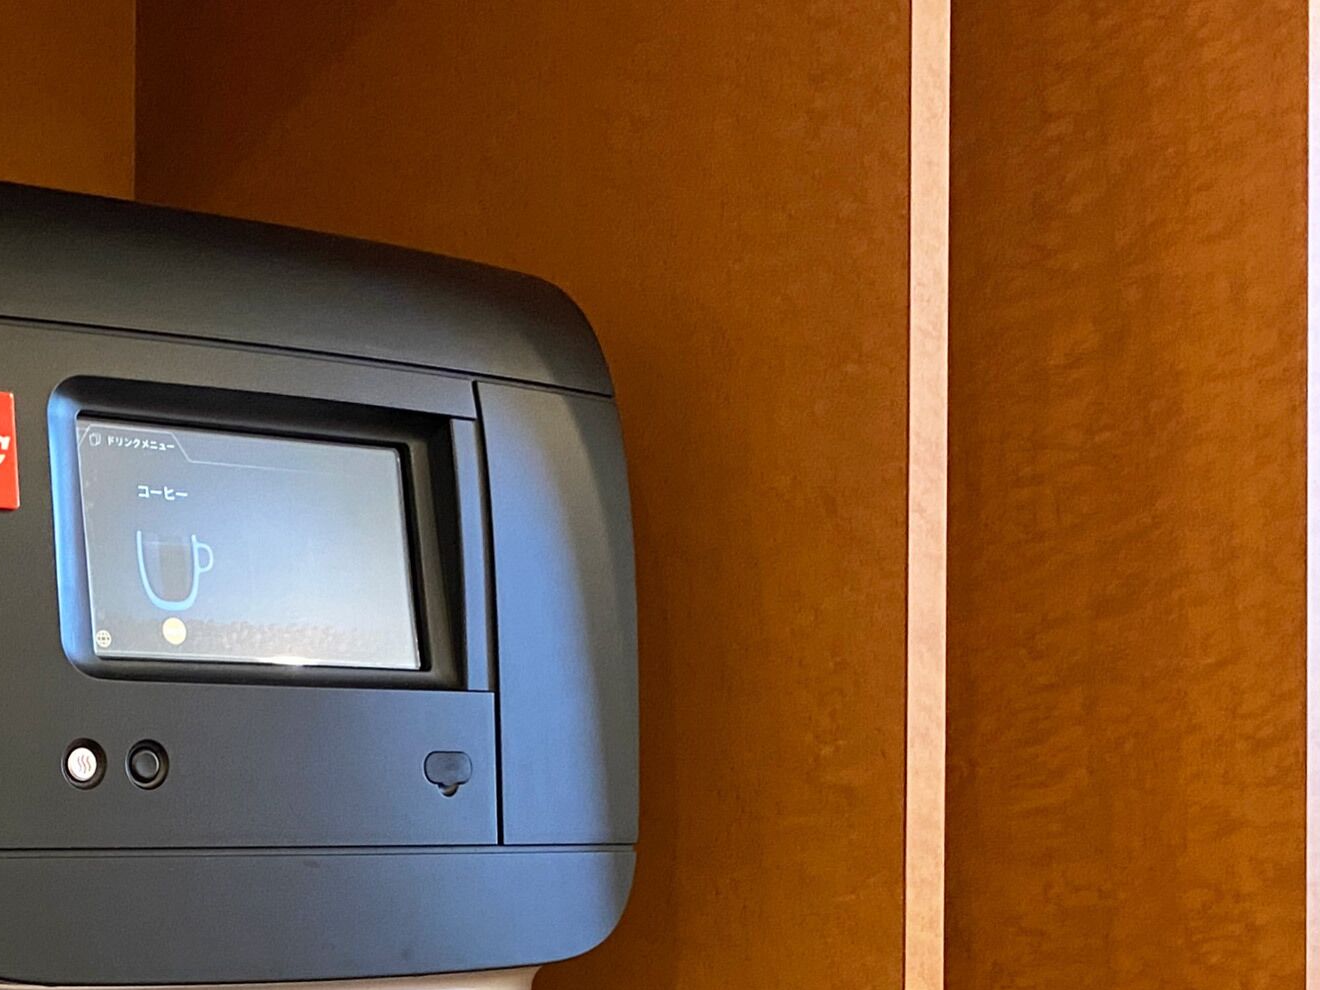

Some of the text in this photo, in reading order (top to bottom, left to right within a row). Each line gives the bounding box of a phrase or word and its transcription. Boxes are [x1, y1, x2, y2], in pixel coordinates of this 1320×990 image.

[107, 435, 176, 451] ドリンクメニュー
[137, 484, 189, 501] コーヒー
